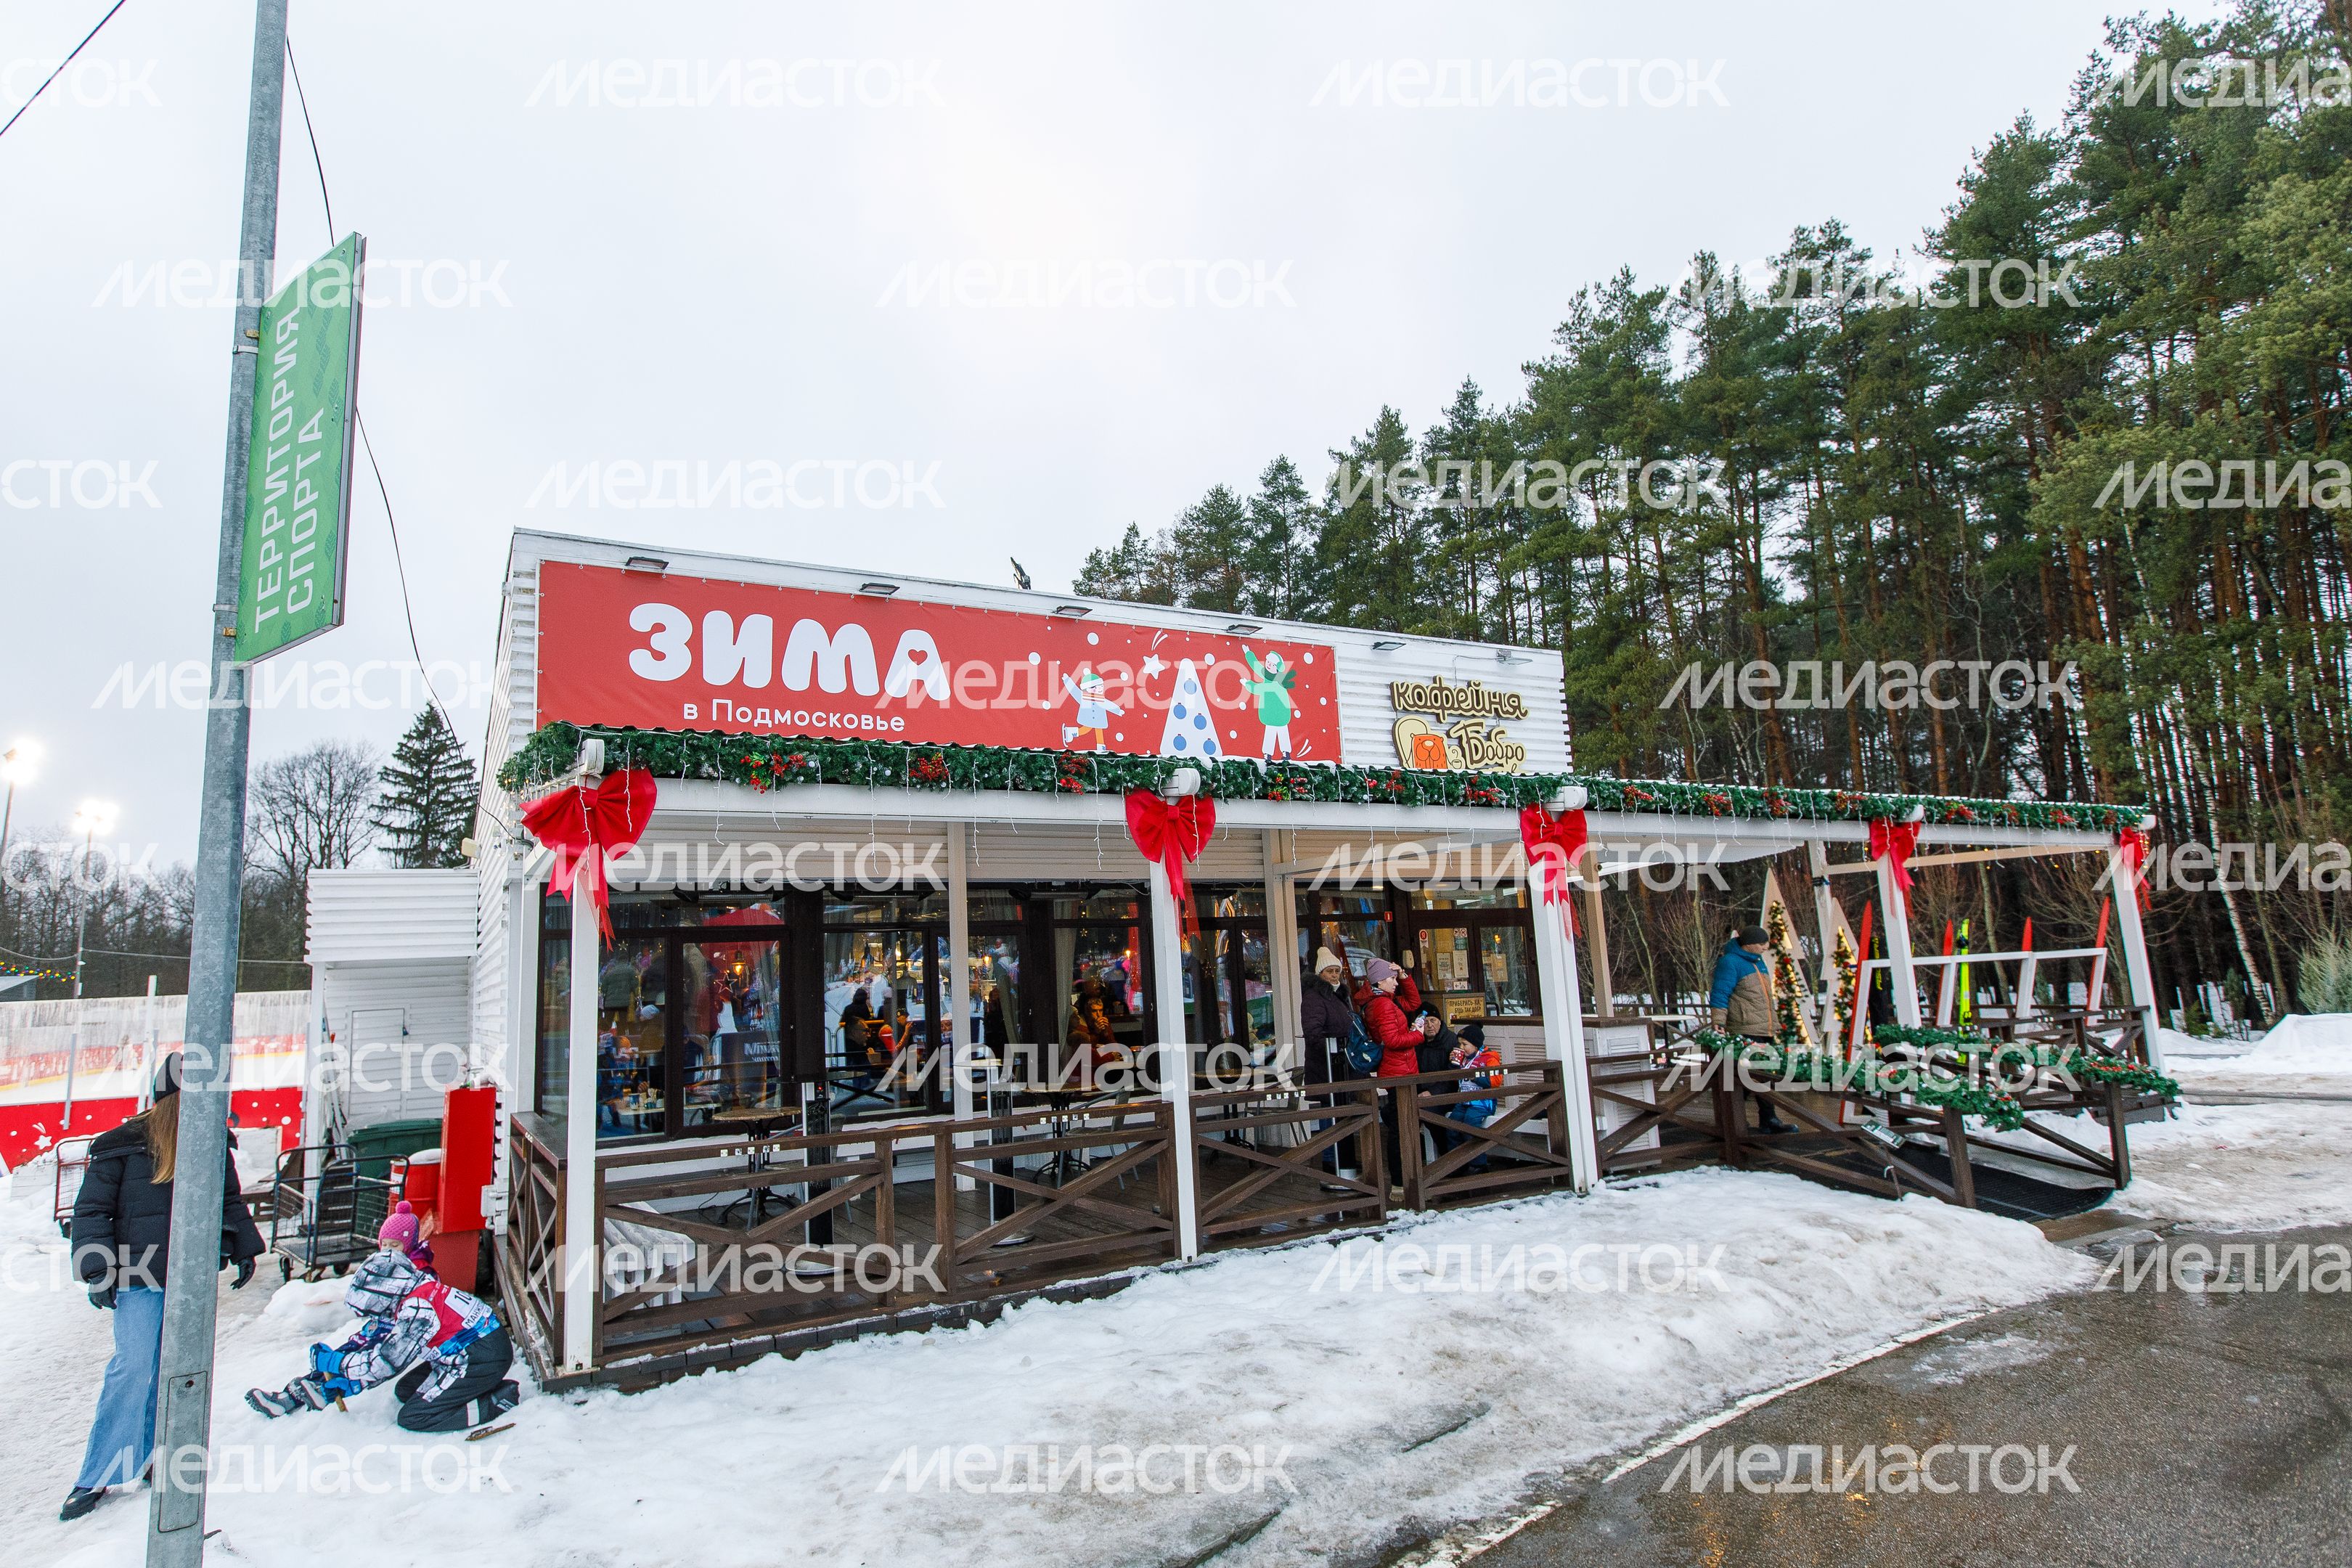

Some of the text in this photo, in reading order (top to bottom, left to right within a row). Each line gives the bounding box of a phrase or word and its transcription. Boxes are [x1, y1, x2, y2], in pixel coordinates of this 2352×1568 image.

[255, 306, 300, 633] ТЕРРИТОРИЯ
[287, 407, 324, 614] СПОРТА
[628, 603, 951, 701] ЗИМА
[1392, 675, 1529, 722] кофейня
[684, 699, 905, 732] в Подмосковье
